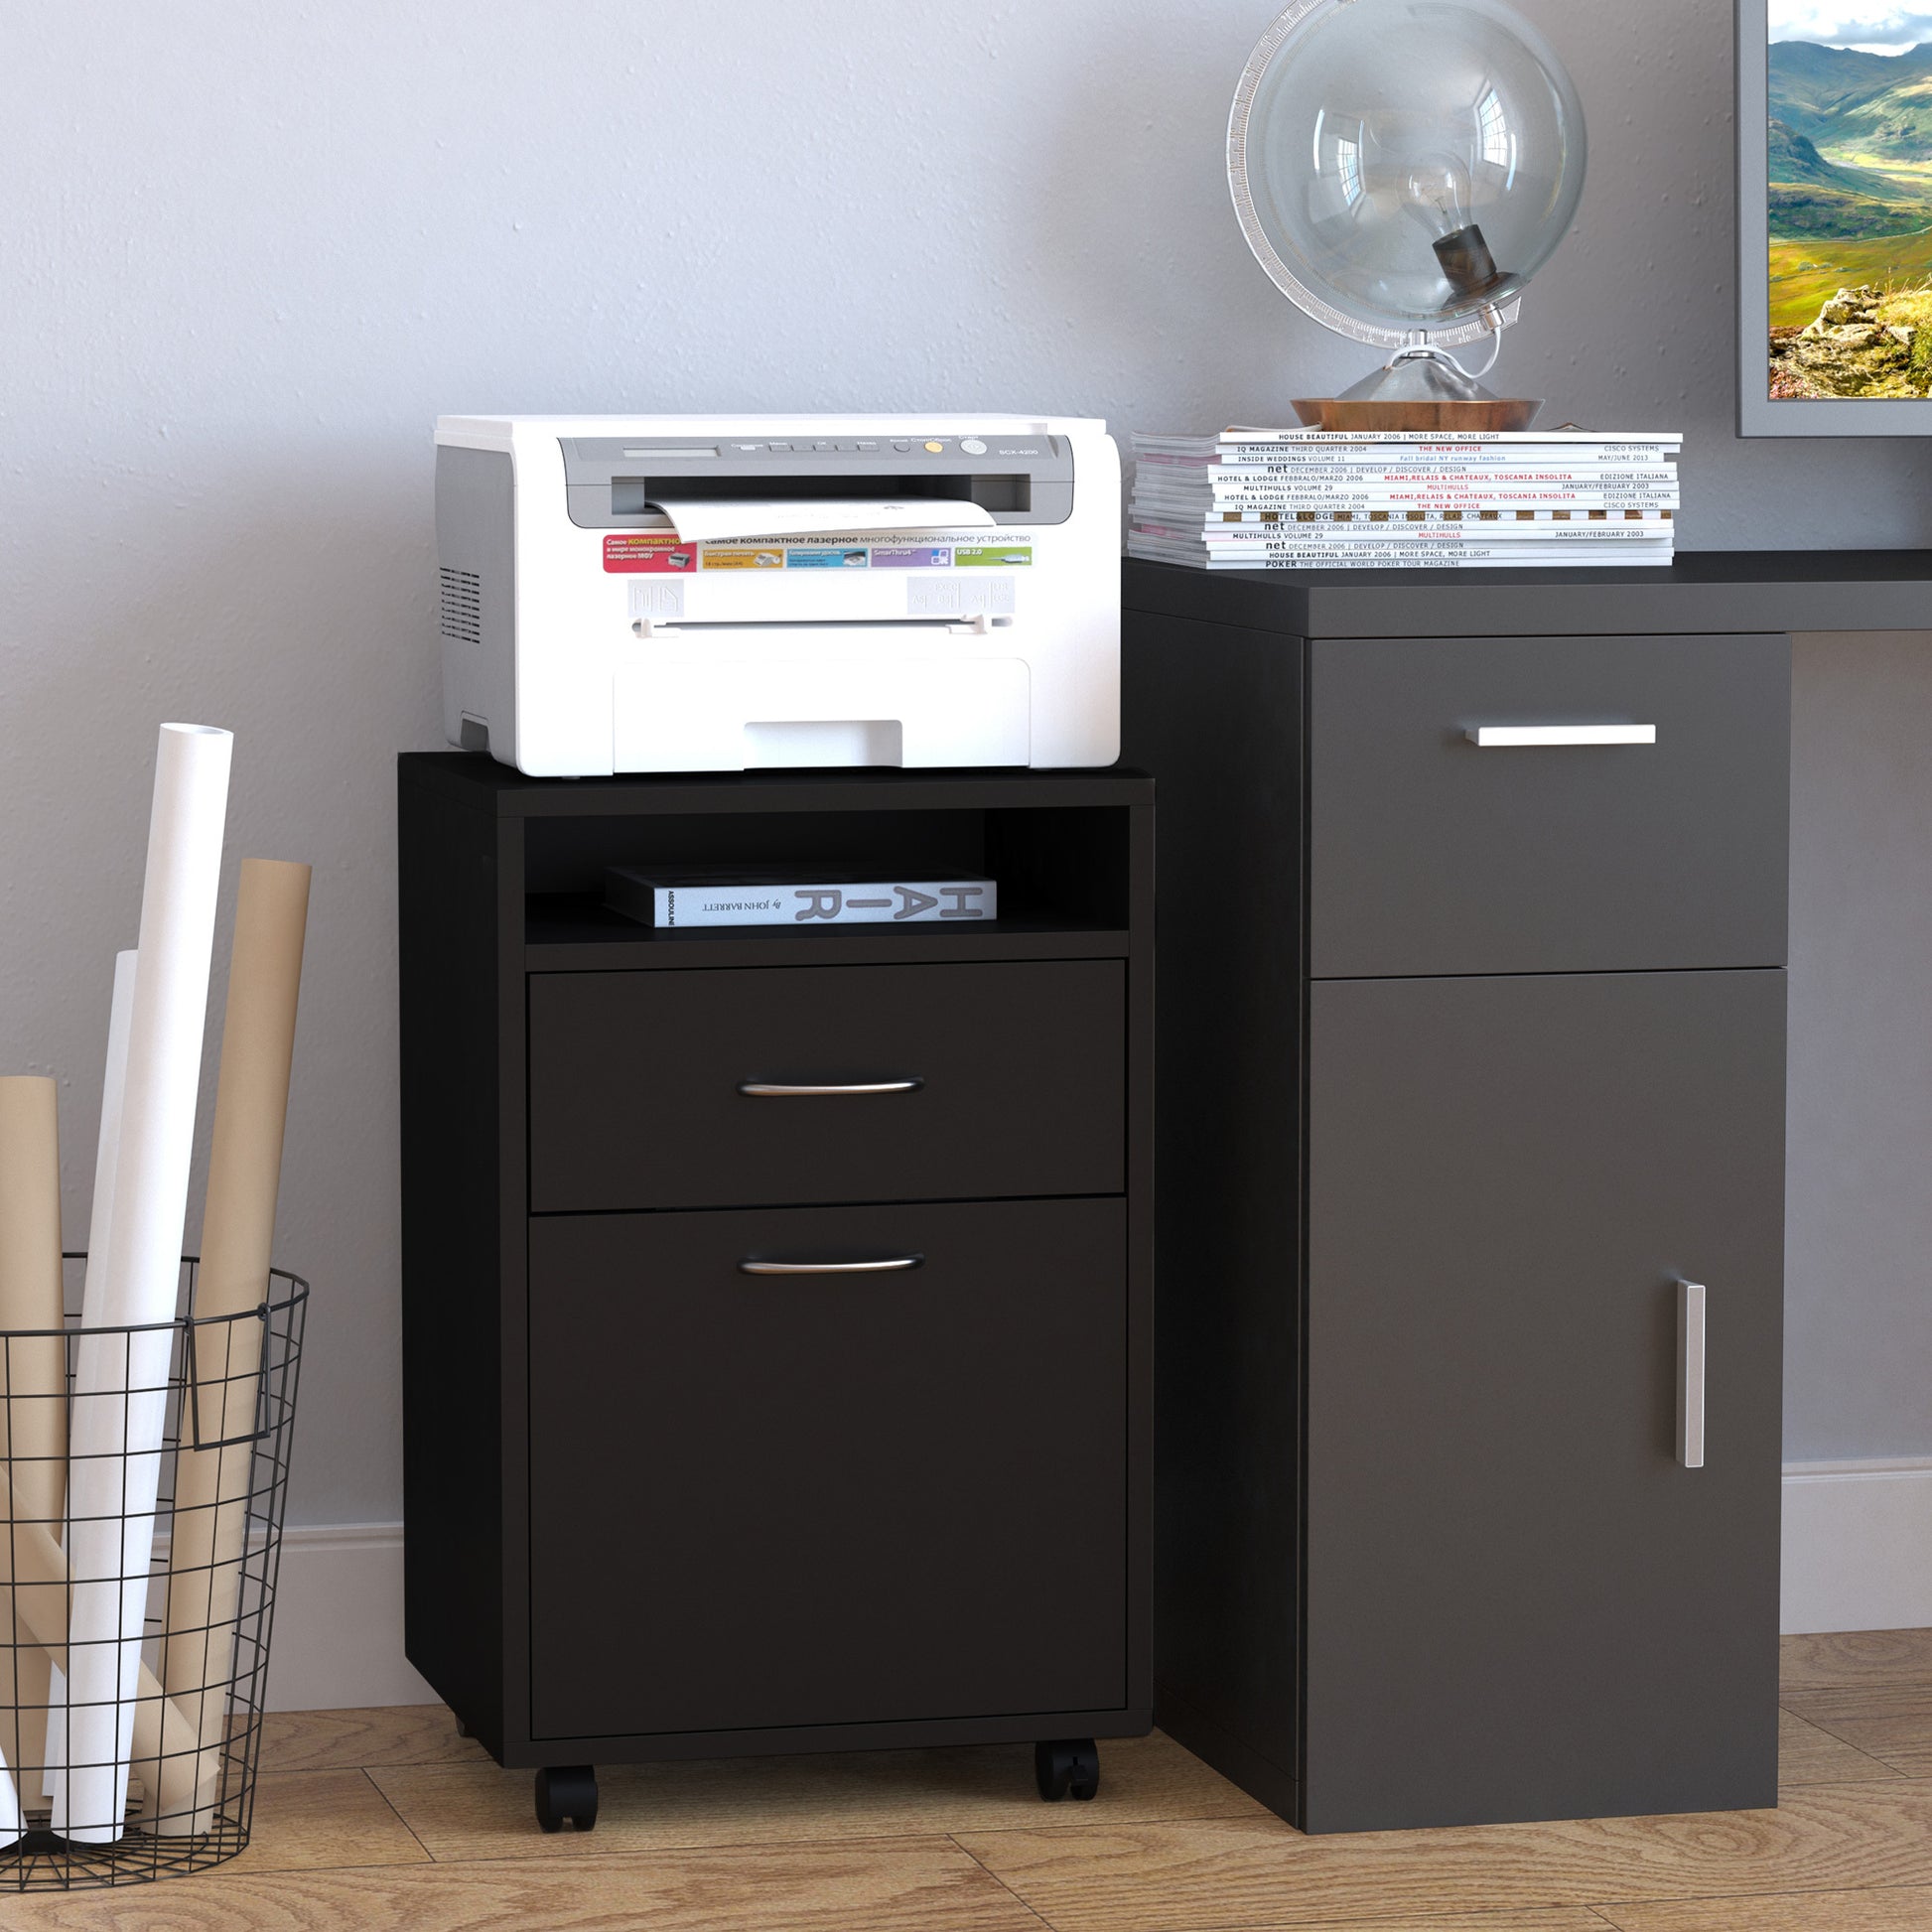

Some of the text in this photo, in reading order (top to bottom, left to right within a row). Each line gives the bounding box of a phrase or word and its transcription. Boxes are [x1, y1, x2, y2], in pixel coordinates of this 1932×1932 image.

[1268, 465, 1288, 474] net
[1264, 522, 1285, 531] net
[977, 534, 1031, 544] устройство
[1266, 541, 1286, 550] net
[703, 898, 781, 911] By JOHN BARRETT
[794, 886, 983, 921] HAIR
